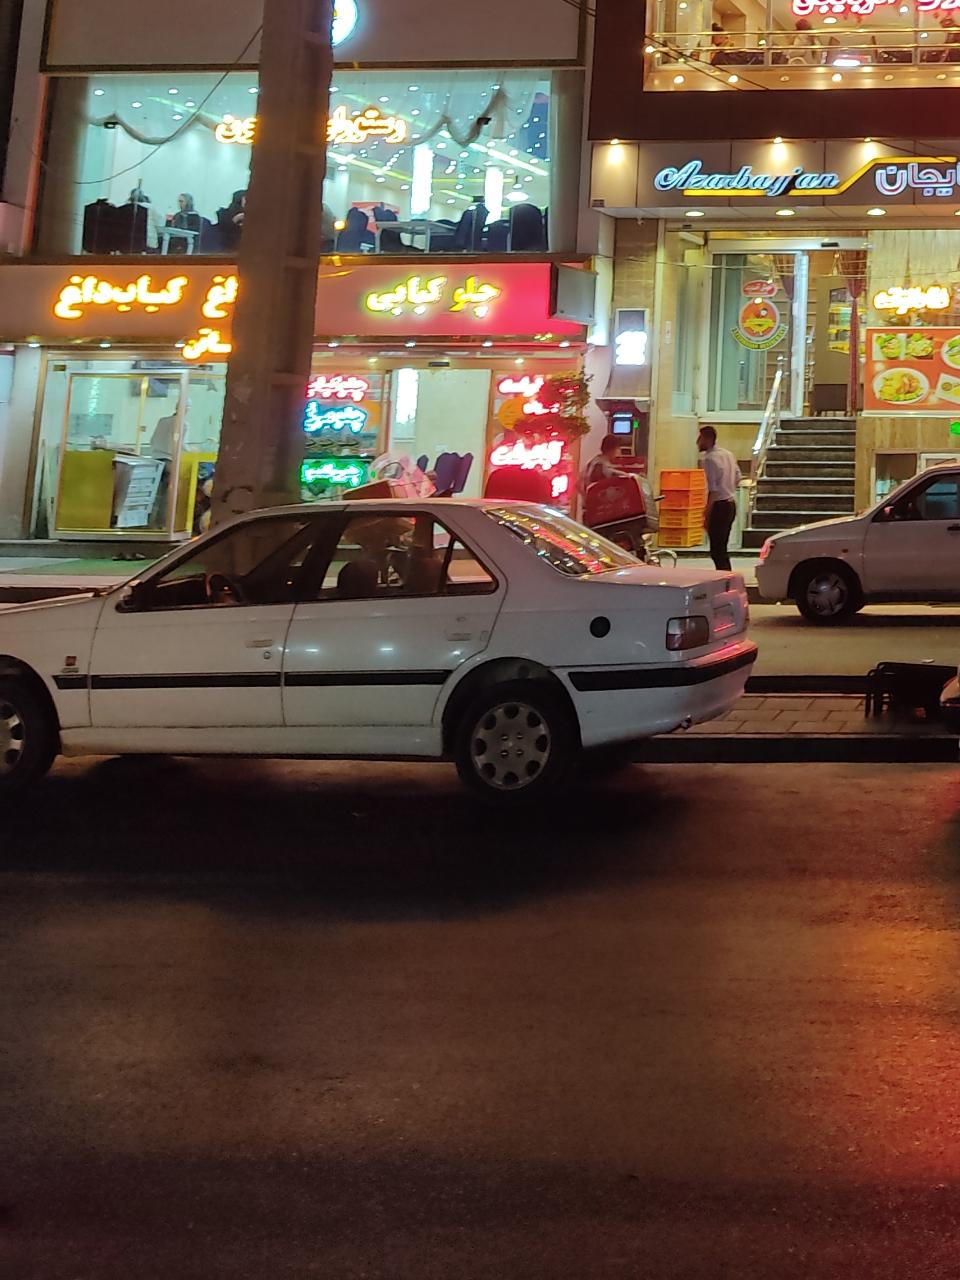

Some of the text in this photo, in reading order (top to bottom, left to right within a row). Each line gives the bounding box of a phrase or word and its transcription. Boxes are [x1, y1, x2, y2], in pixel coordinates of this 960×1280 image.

[54, 275, 114, 319] داغ
[112, 274, 189, 313] کباب
[366, 275, 501, 319] چلو کبابی
